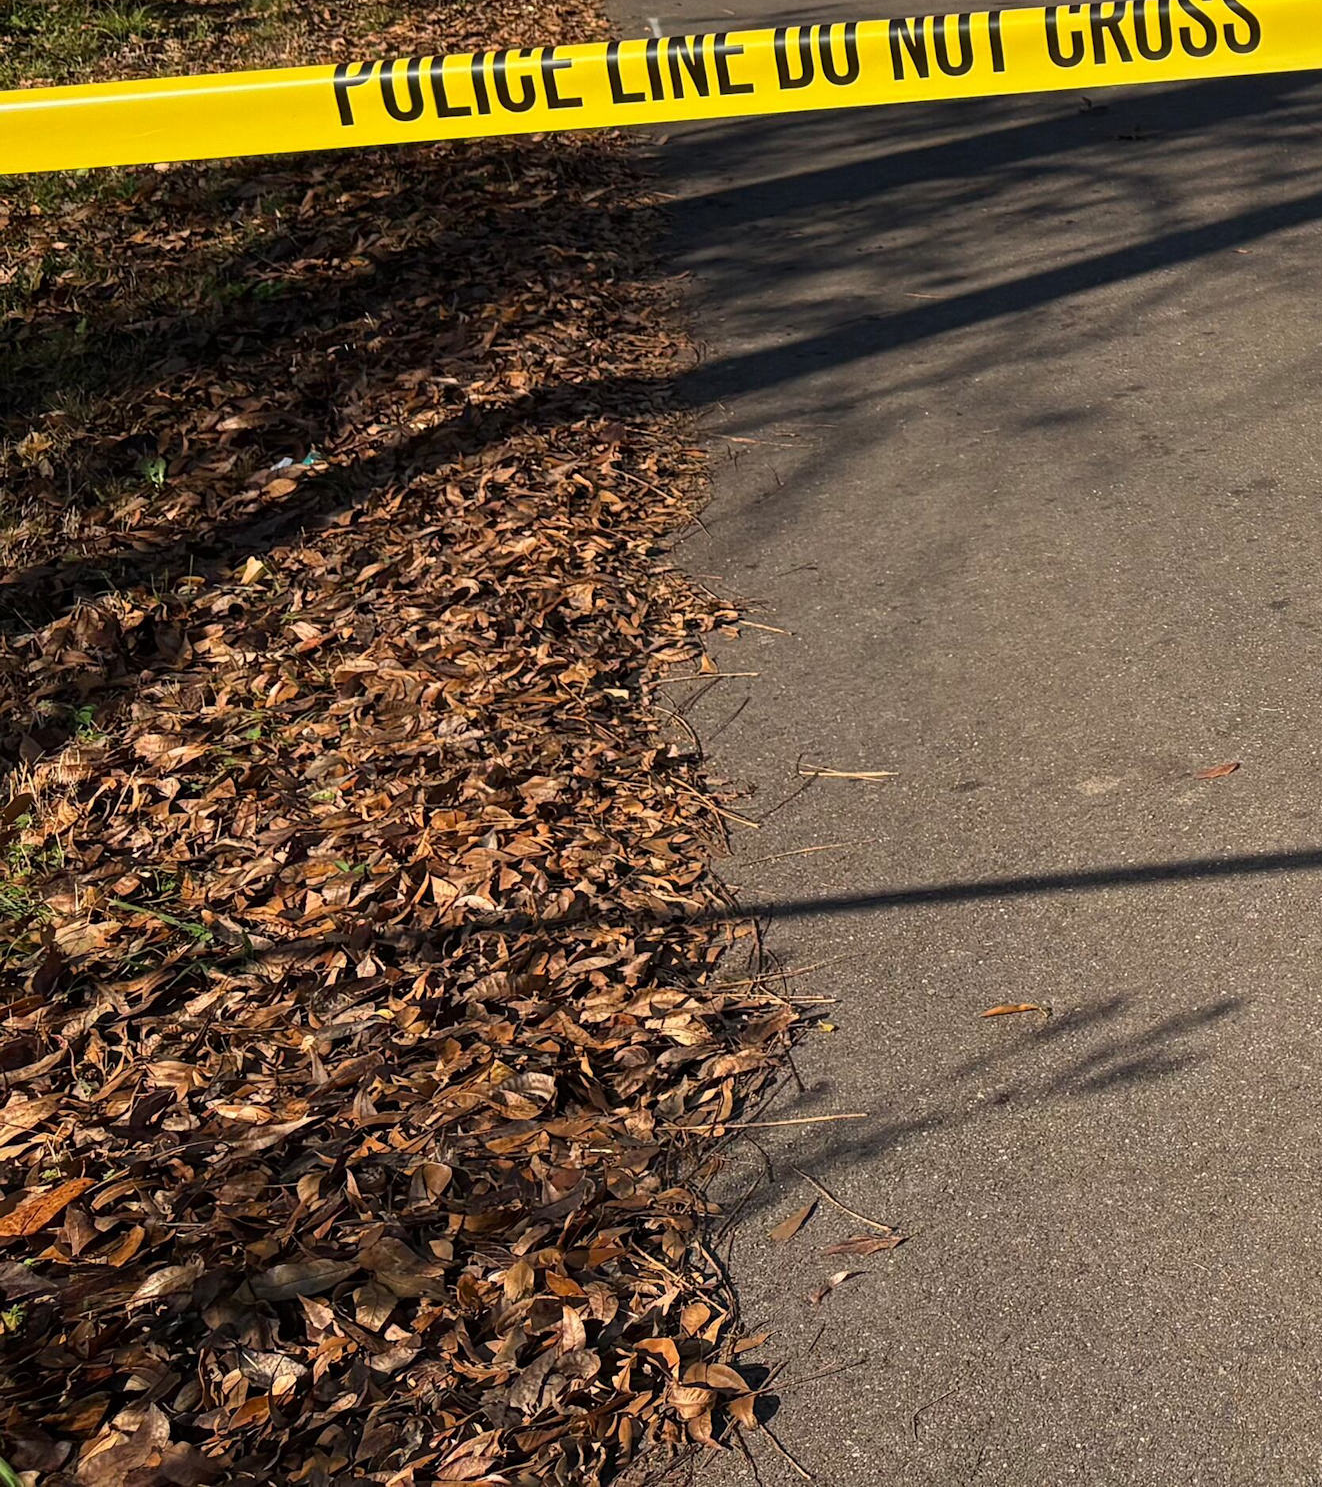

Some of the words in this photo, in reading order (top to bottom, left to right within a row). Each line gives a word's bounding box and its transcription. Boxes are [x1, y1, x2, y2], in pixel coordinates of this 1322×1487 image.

[333, 47, 584, 126] POLICE
[606, 32, 755, 104] LINE
[773, 22, 861, 90] DO
[887, 10, 1006, 81] NOT
